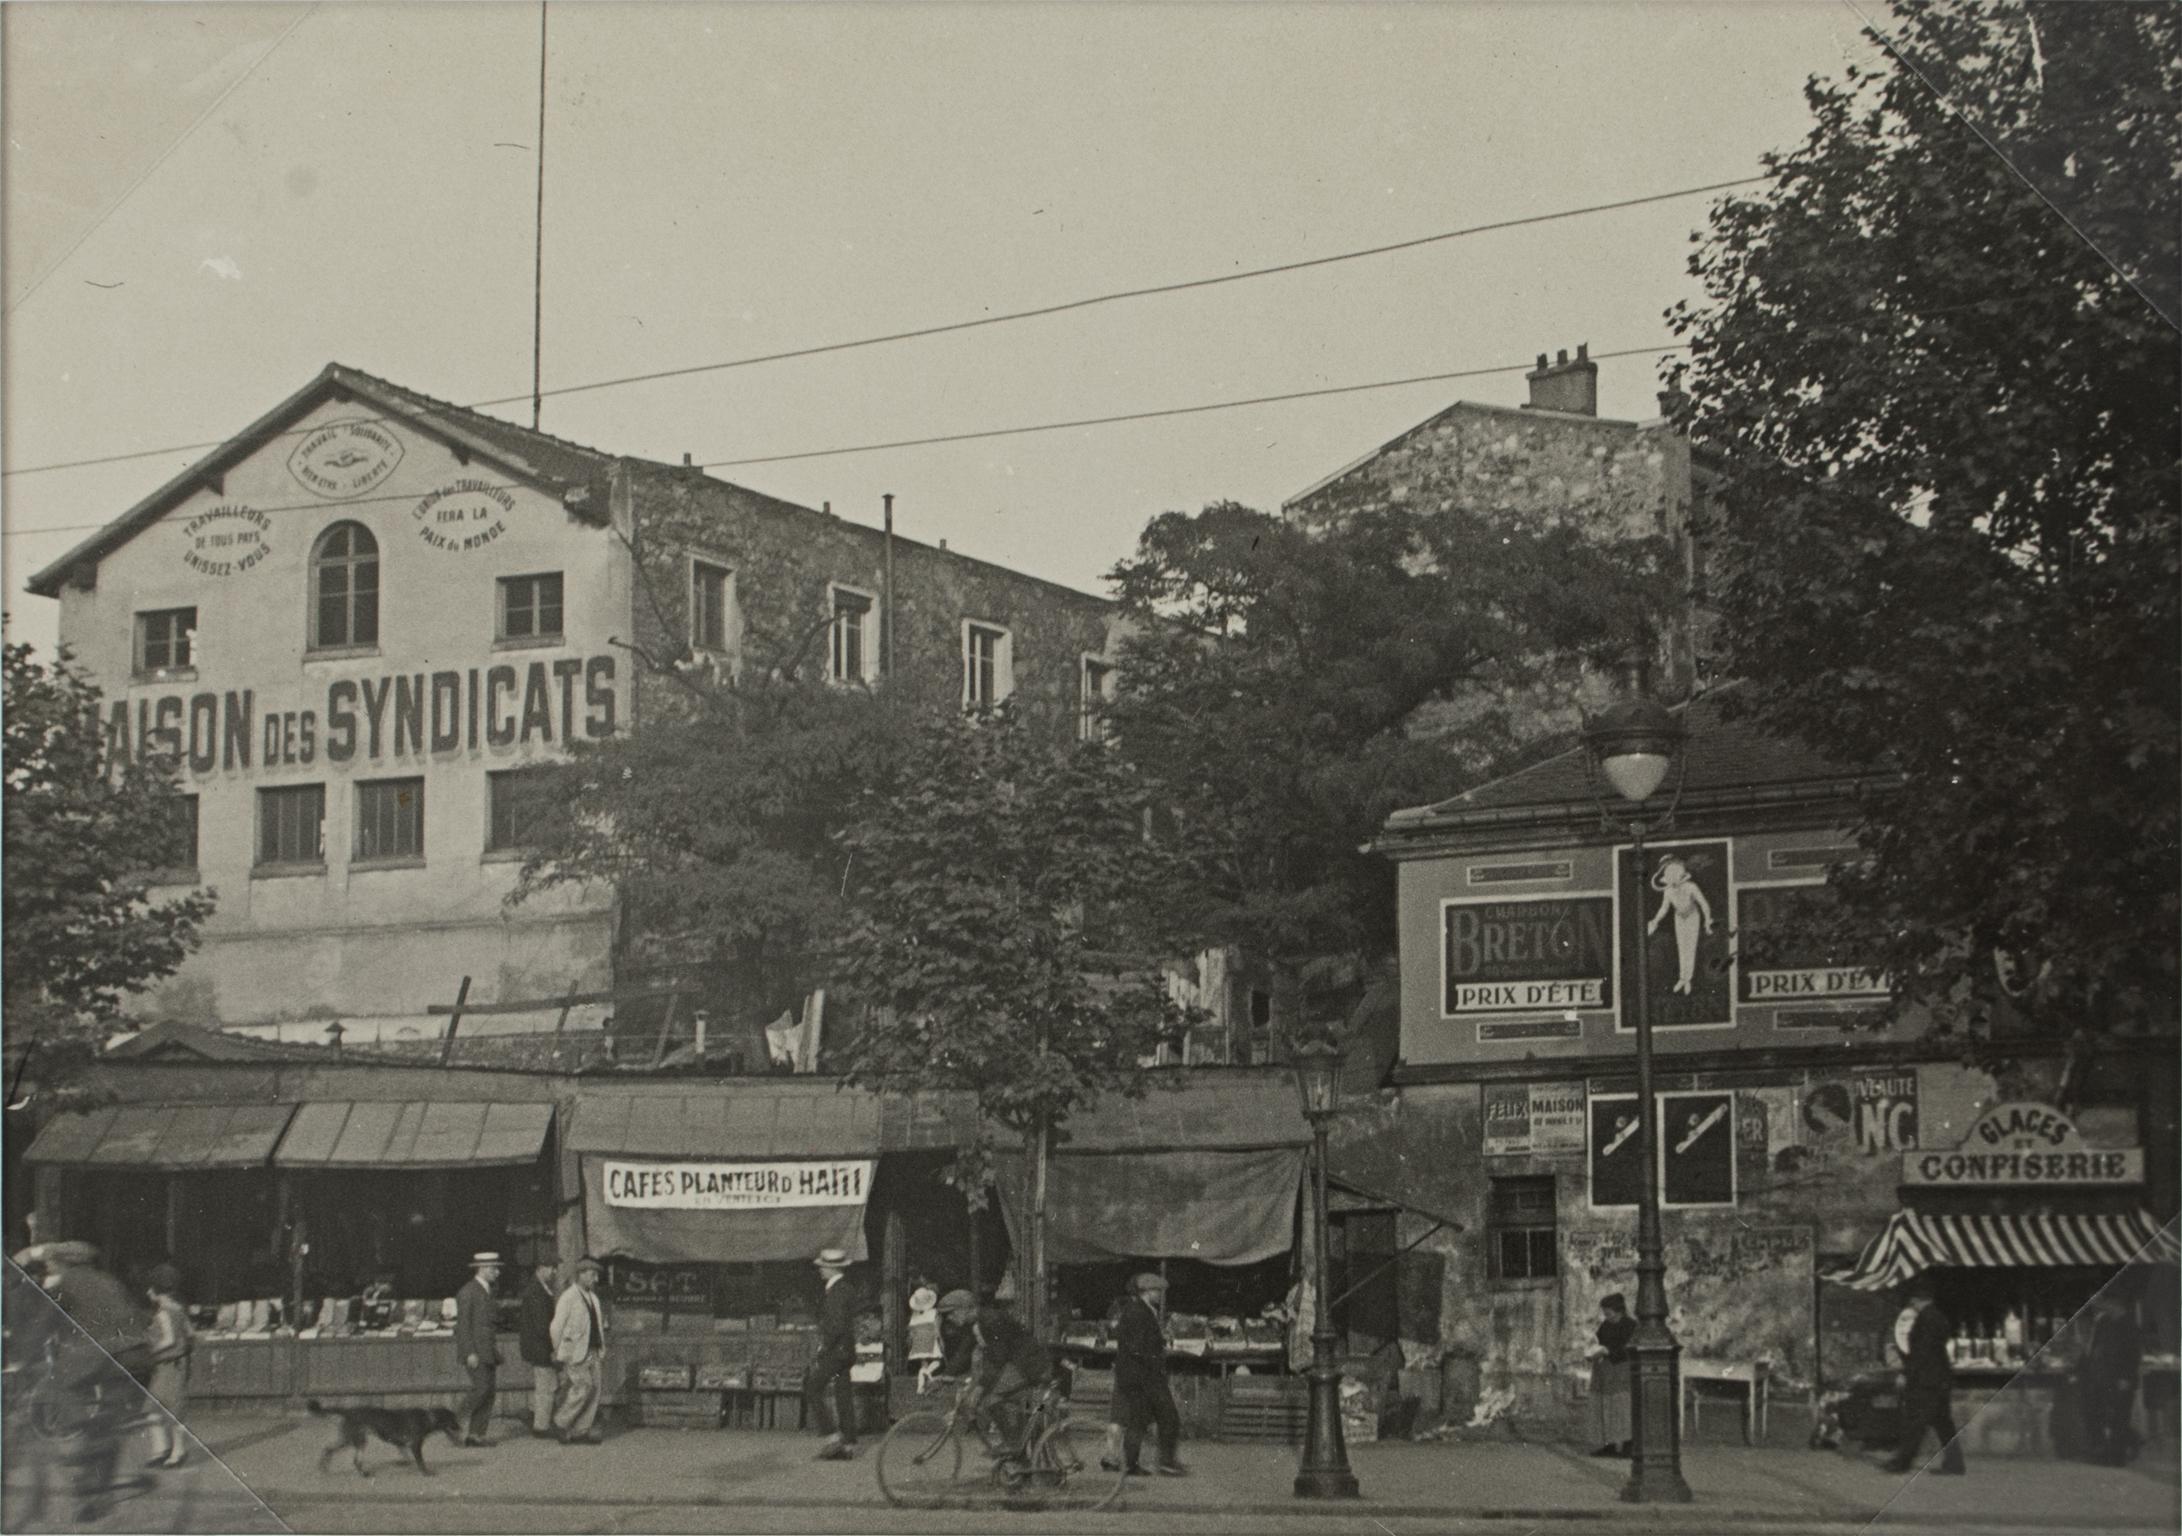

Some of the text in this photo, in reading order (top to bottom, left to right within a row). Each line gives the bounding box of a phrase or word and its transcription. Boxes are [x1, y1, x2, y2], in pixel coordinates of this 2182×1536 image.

[456, 479, 517, 512] TRAVAILLEURS
[182, 504, 272, 538] TRAVAILLEURS
[436, 506, 488, 523] FERA LA
[194, 530, 261, 550] DE TOUS PAYS
[418, 525, 448, 550] PAIX
[463, 519, 507, 552] MONDE
[183, 541, 272, 577] UNISSEZ-VOUS
[264, 709, 316, 767] DES
[327, 656, 616, 763] SYNDICATS
[1451, 901, 1610, 976] BRETON
[1462, 986, 1516, 1006] PRIX
[1756, 974, 1815, 994] PRIX
[1532, 1099, 1585, 1114] MAISON
[1979, 1108, 2070, 1145] GLACES
[2013, 1138, 2034, 1150] ET
[1919, 1153, 2126, 1182] CONFISERIE
[681, 1169, 780, 1196] PLANTEUR
